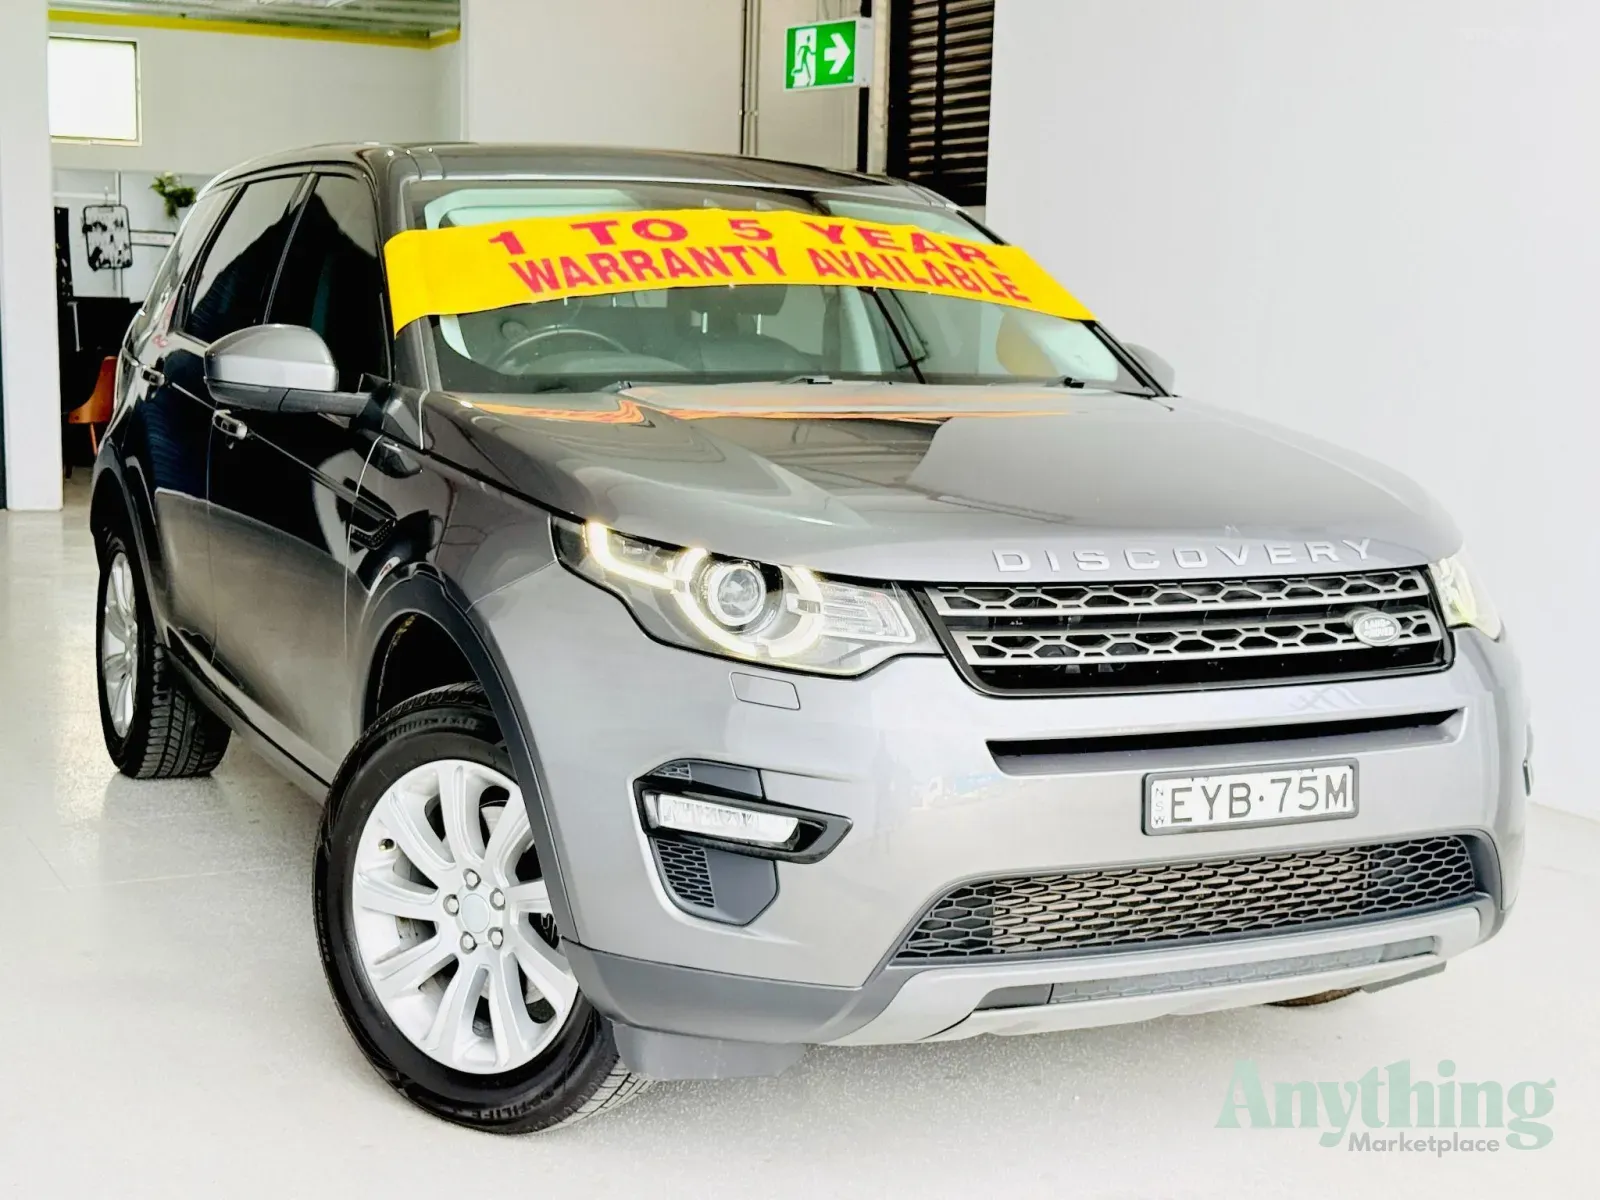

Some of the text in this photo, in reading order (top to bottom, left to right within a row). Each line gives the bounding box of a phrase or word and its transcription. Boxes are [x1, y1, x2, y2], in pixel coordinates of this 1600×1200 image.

[488, 218, 998, 268] 1 TO 5 YEAR
[508, 245, 1032, 302] WARRANTY AVAILABLE
[992, 538, 1372, 572] DISCOVERY
